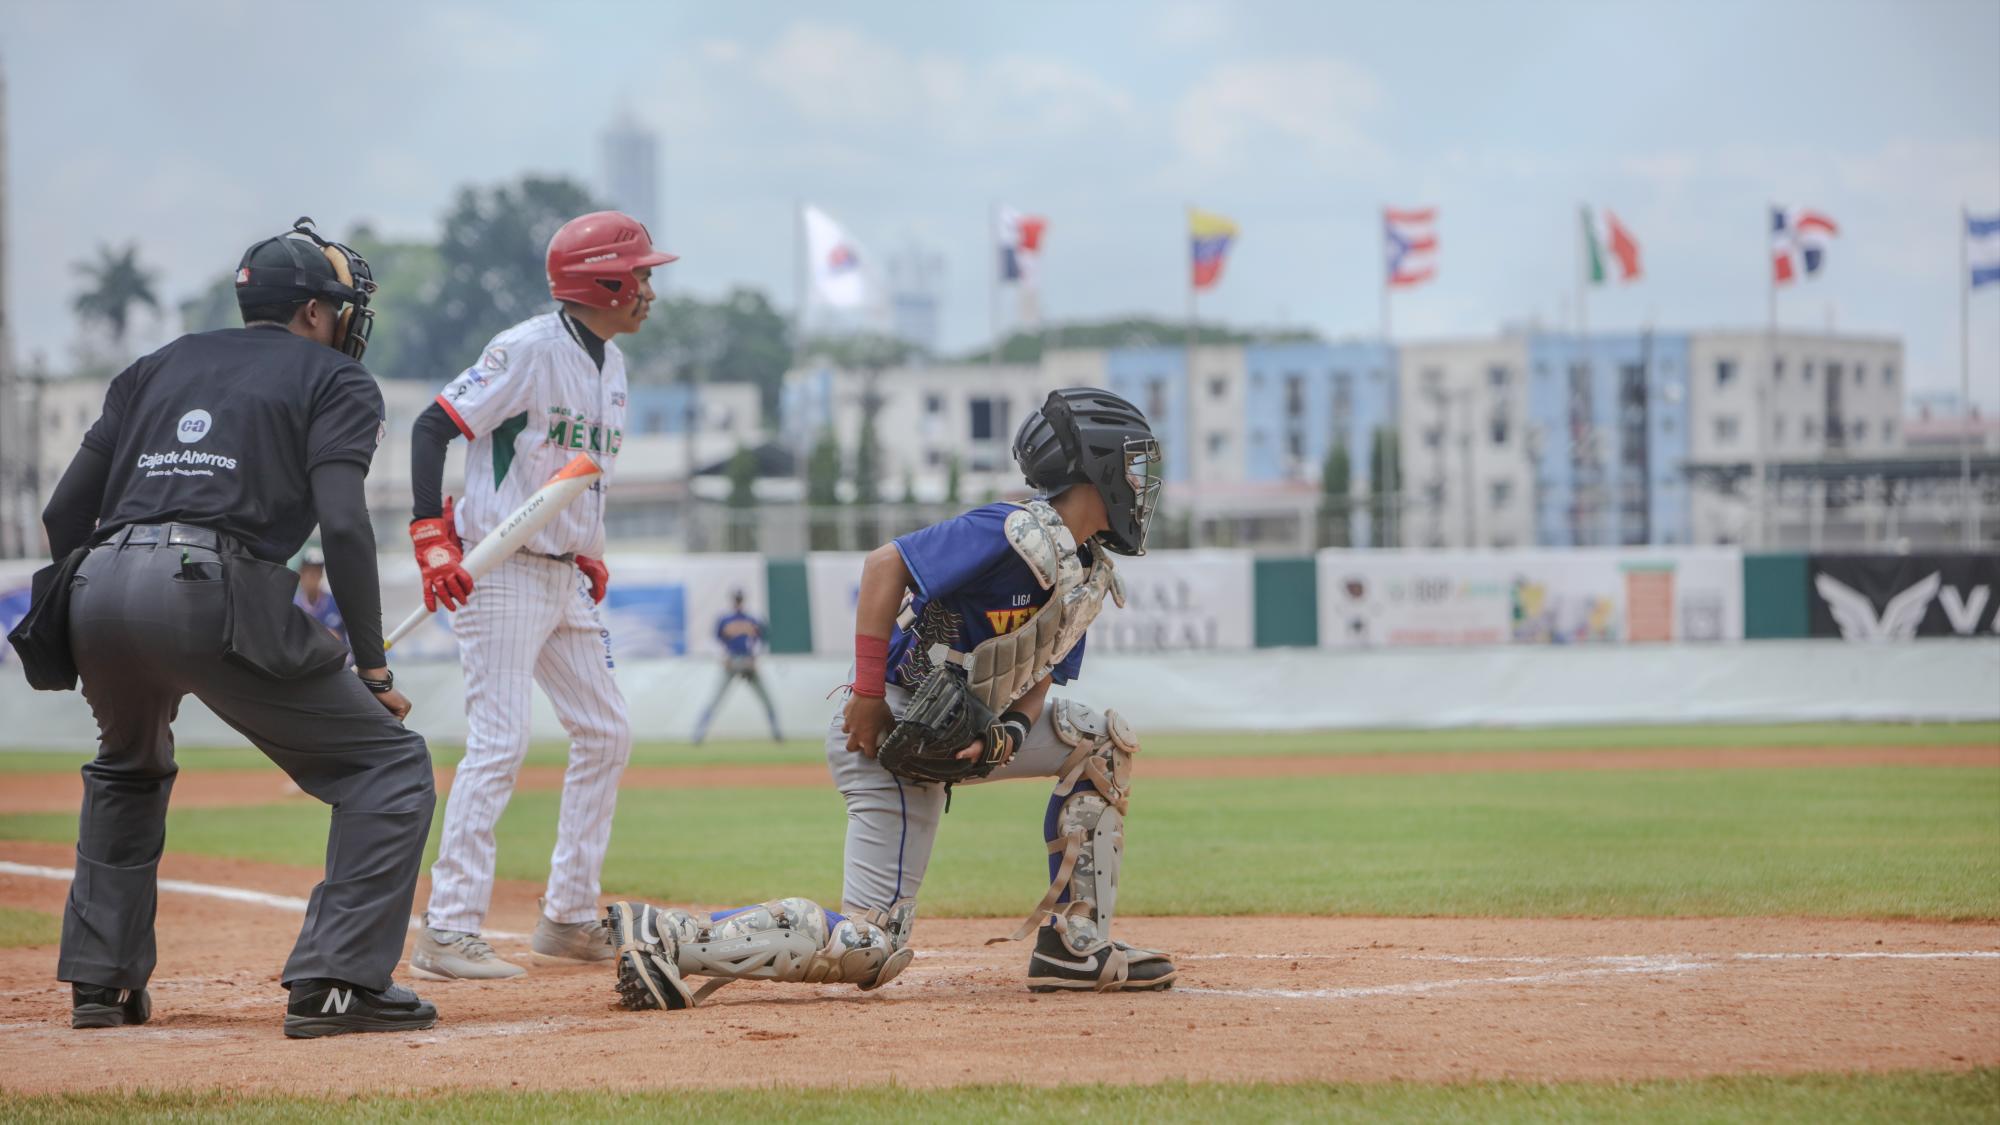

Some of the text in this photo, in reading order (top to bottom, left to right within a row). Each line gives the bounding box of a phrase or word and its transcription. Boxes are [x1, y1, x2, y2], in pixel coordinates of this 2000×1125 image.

[181, 419, 206, 433] ca
[179, 450, 237, 470] Ahorros
[500, 496, 545, 538] EASTON
[1012, 593, 1031, 607] LIGA
[321, 987, 352, 1014] N
